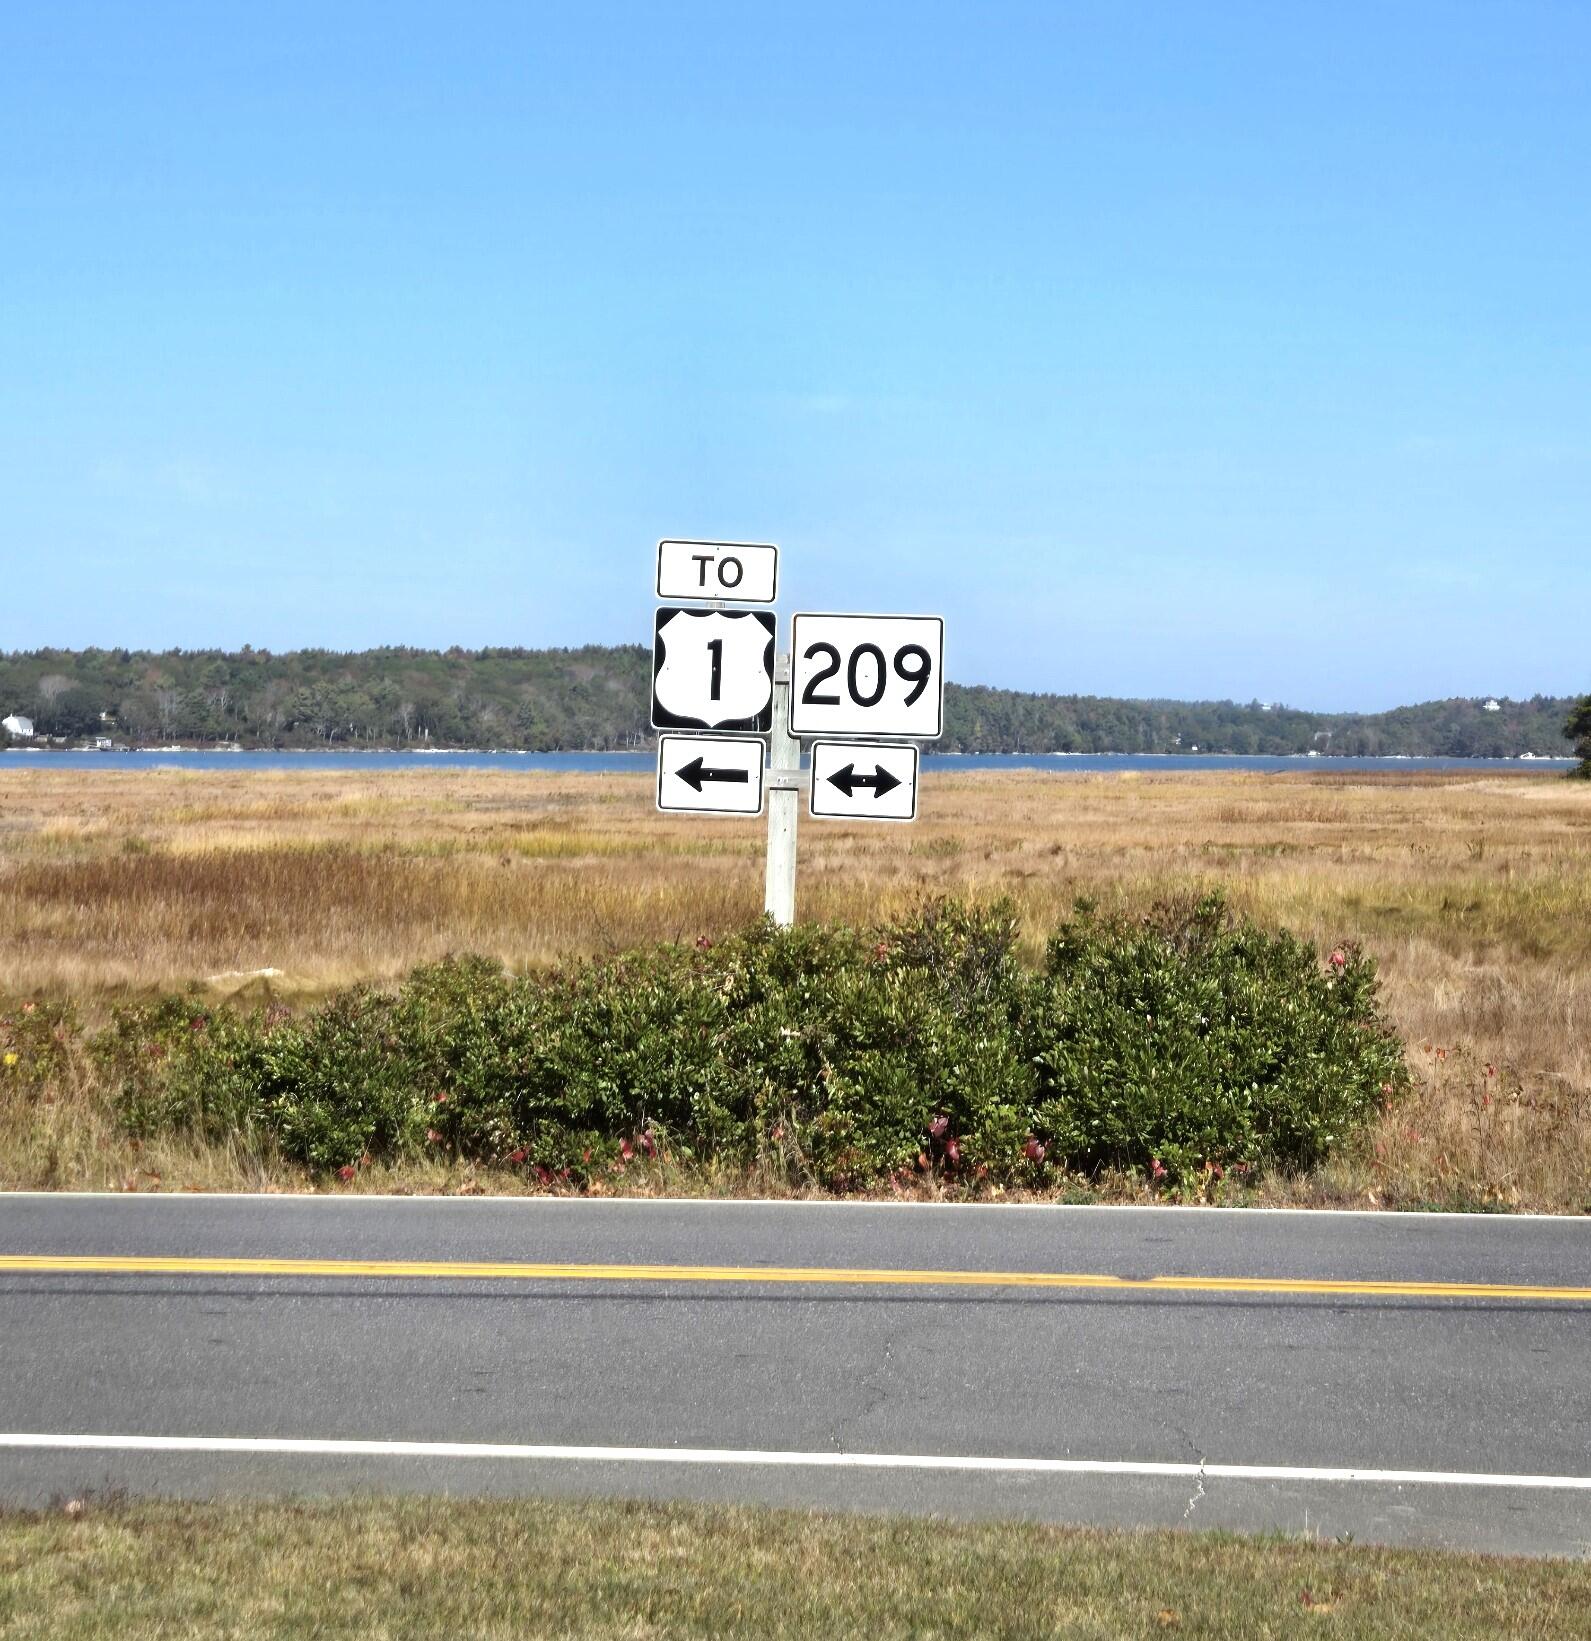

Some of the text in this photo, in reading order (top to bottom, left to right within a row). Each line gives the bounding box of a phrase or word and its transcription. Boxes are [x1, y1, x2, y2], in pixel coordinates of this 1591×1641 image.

[691, 555, 744, 588] TO
[707, 639, 723, 701] 1
[801, 642, 932, 708] 209
